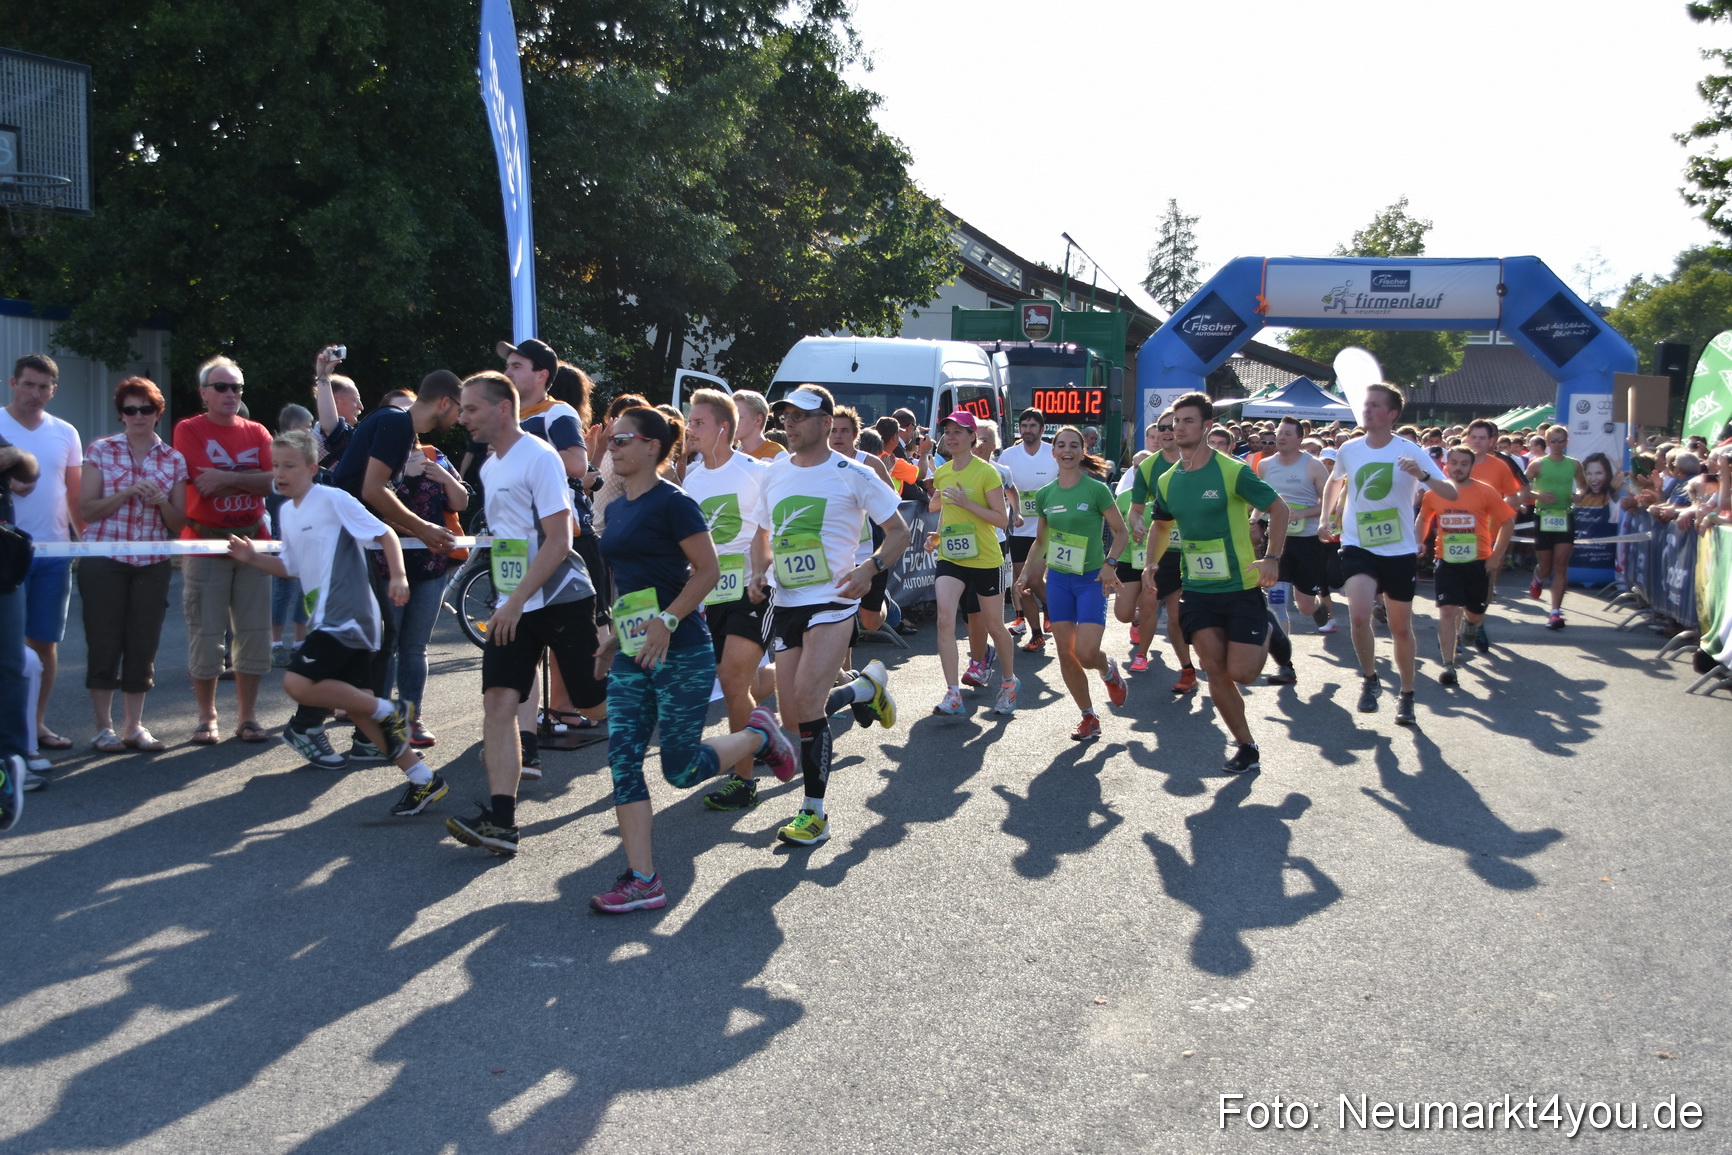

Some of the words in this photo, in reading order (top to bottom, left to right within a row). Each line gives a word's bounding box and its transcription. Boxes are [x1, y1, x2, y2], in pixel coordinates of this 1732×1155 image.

[1355, 293, 1444, 309] firmenlauf
[1191, 322, 1236, 331] Fischer
[1688, 391, 1721, 424] AOK
[1202, 490, 1219, 498] AOK
[1025, 500, 1036, 511] 98
[1442, 516, 1471, 525] OBI
[1543, 517, 1565, 526] 1480
[1366, 523, 1392, 537] 119
[946, 538, 970, 551] 658
[1449, 545, 1471, 555] 624
[1057, 547, 1072, 561] 21
[501, 561, 522, 579] 979
[784, 554, 816, 573] 120
[1197, 556, 1214, 570] 19
[819, 731, 830, 783] BOOSTER
